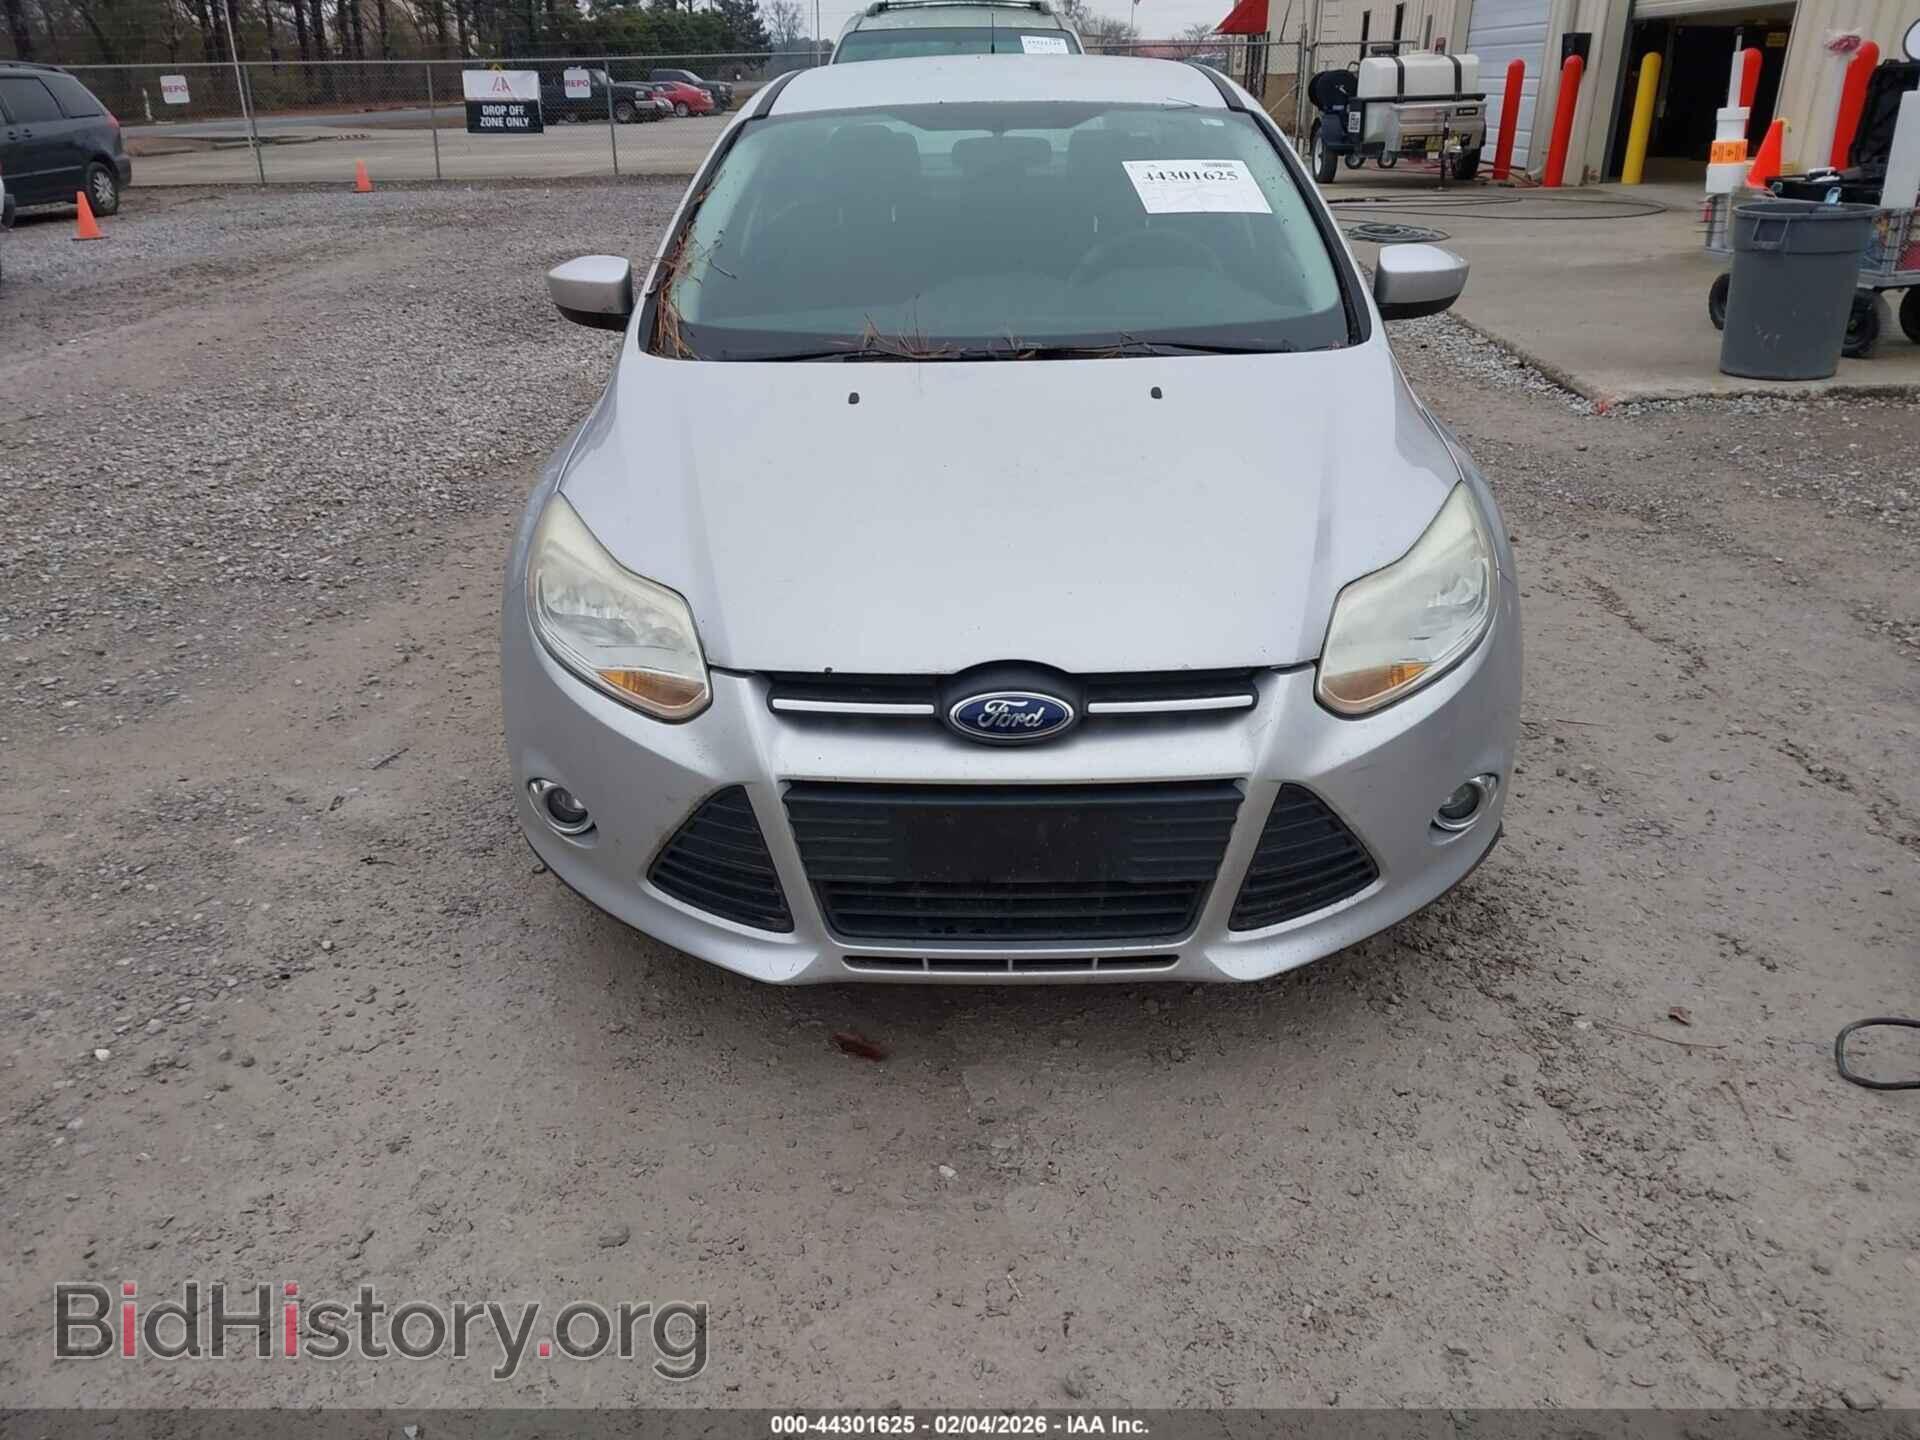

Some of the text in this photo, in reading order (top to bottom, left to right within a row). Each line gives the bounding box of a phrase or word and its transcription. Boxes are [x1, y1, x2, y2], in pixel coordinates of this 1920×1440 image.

[565, 79, 589, 88] REPO
[482, 104, 525, 116] DROP OFF
[480, 116, 529, 127] ZONE ONLY
[977, 699, 1045, 727] Ford
